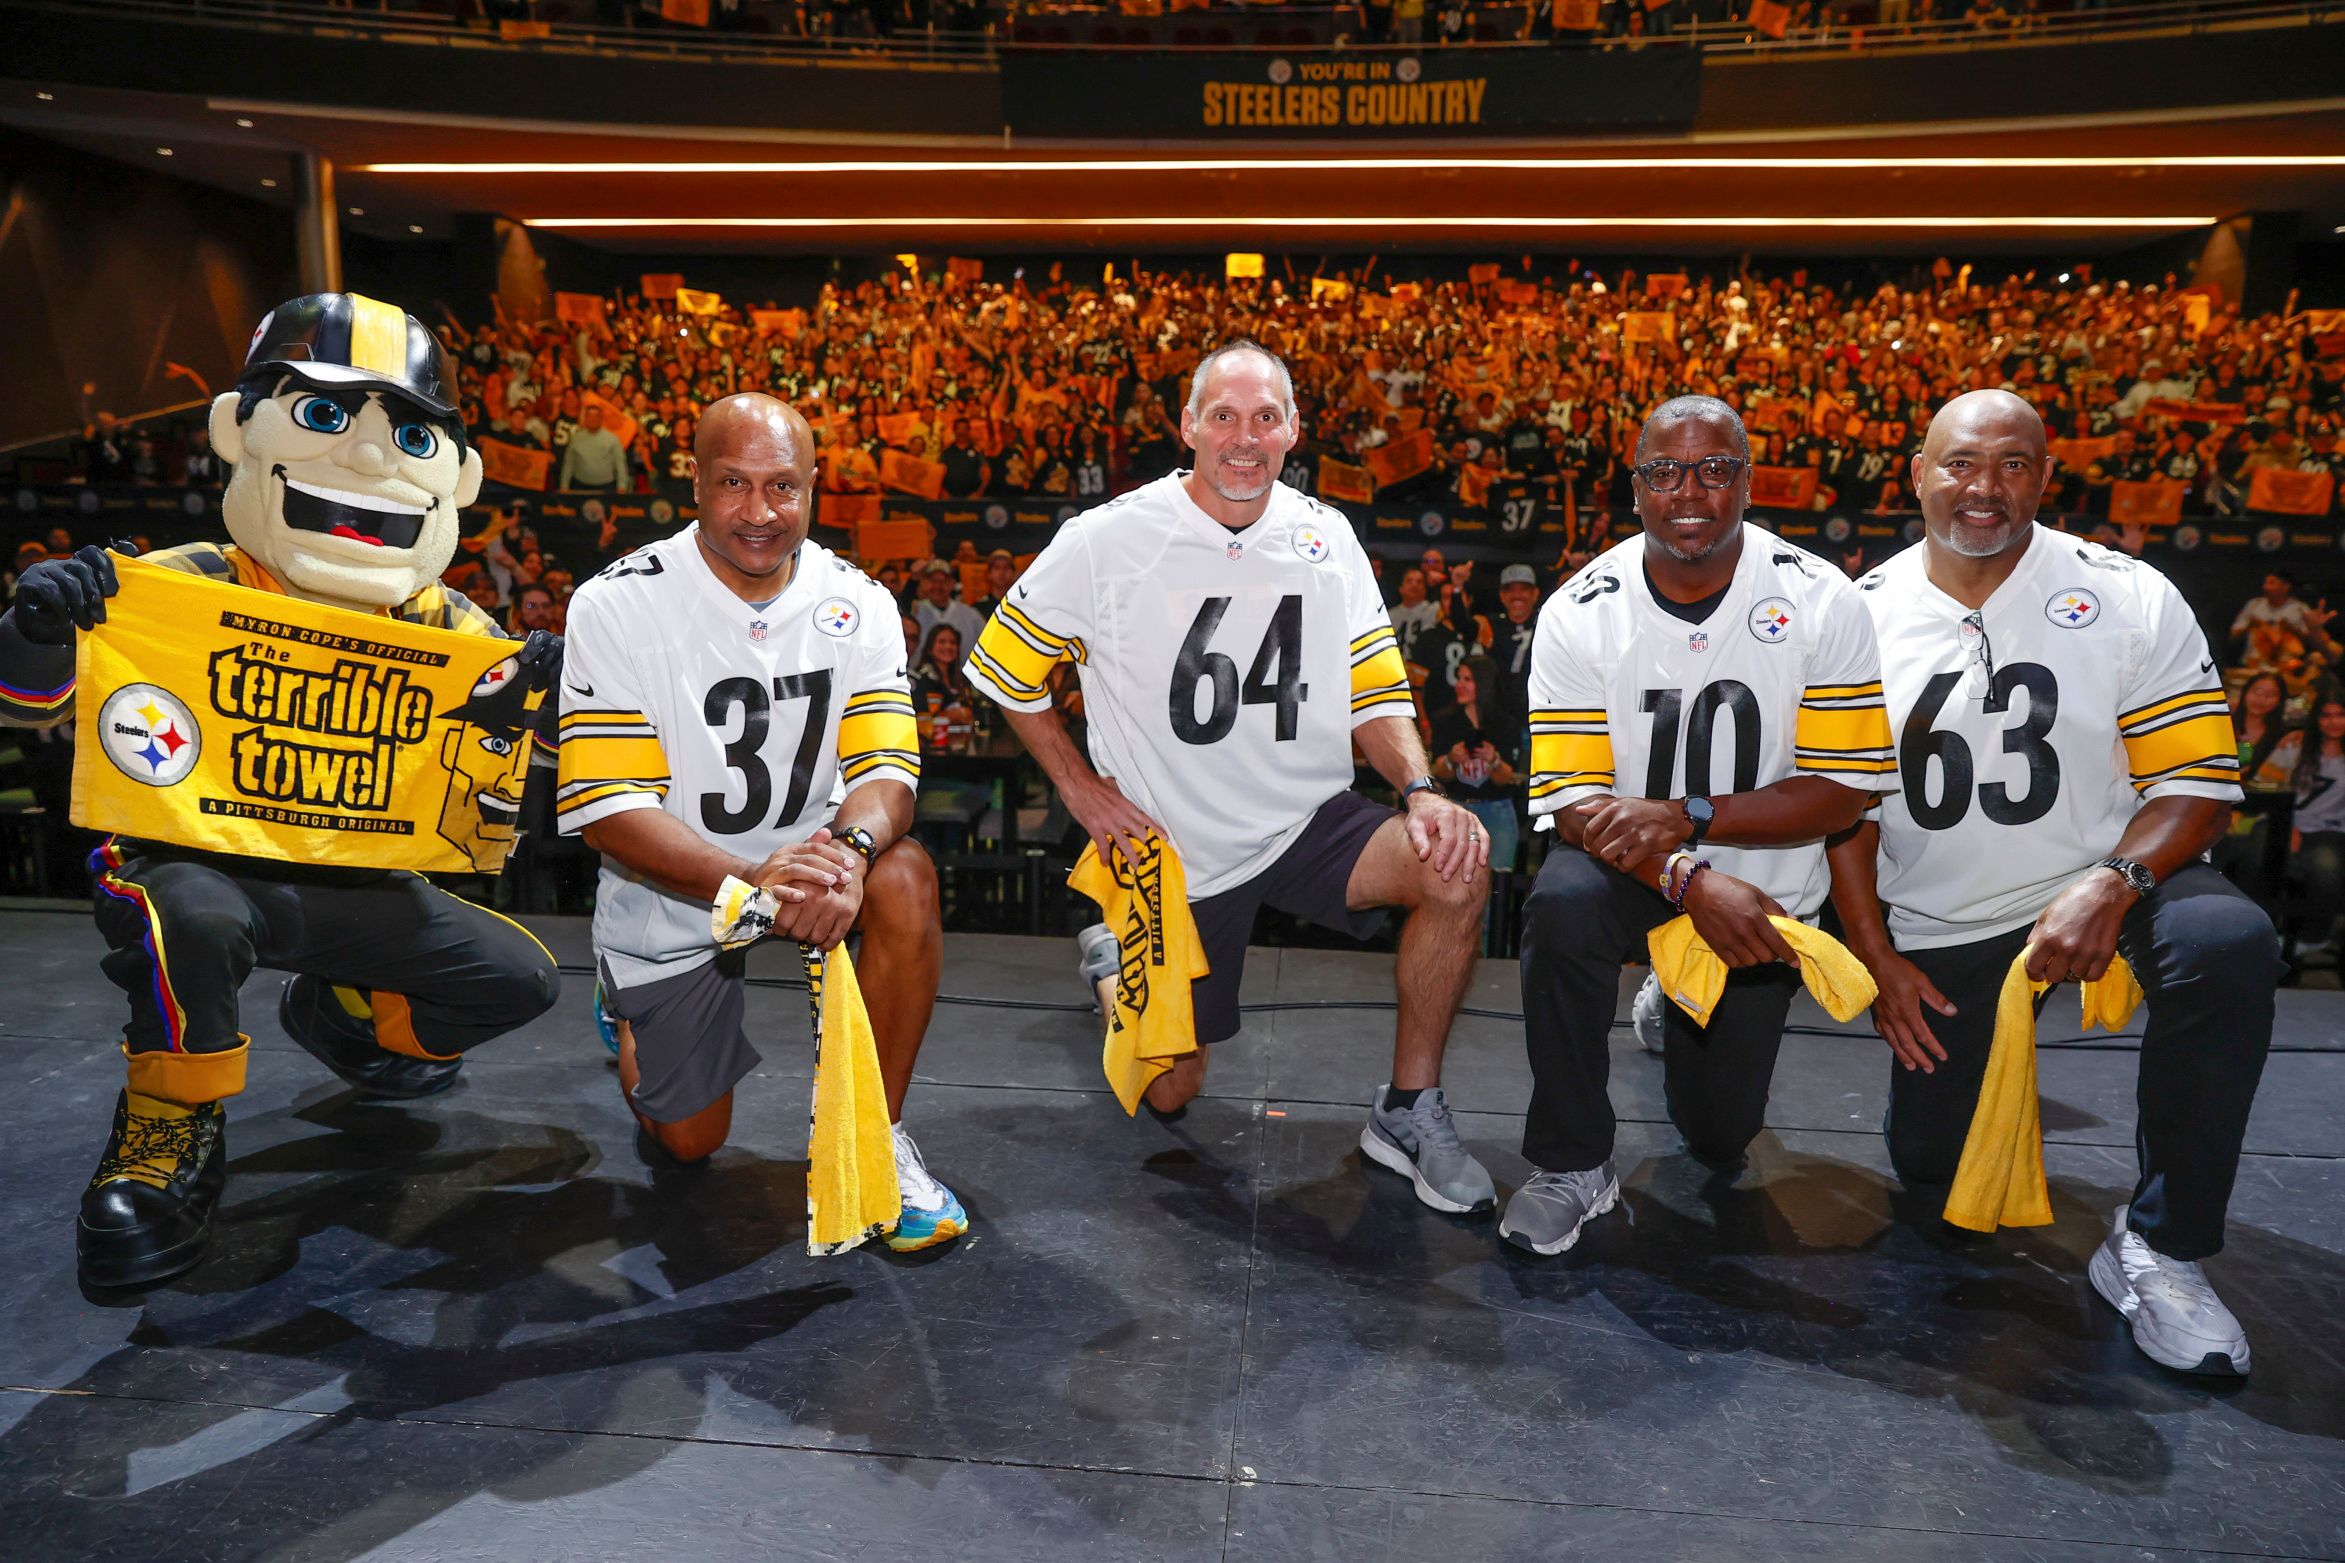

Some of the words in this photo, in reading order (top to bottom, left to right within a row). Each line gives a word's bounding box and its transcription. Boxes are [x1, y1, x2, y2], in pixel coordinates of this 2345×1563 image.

[1298, 62, 1366, 81] YOU'RE
[1371, 62, 1391, 80] IN
[1203, 80, 1340, 127] STEELERS
[1346, 78, 1487, 126] COUNTRY
[1501, 498, 1536, 532] 37
[234, 615, 291, 639] MYRON
[299, 629, 358, 652] COPE'S
[366, 643, 439, 664] OFFICIAL
[251, 642, 290, 662] The
[1691, 641, 1707, 651] NFL
[209, 645, 433, 743] terrible
[1168, 594, 1309, 745] 64
[114, 723, 149, 739] Steelers
[700, 667, 833, 835] 37
[1638, 679, 1761, 801] 10
[1900, 662, 2060, 830] 63
[231, 726, 397, 811] towel
[208, 802, 217, 813] A
[226, 803, 330, 828] PITTSBURGH
[338, 818, 406, 834] ORIGINAL
